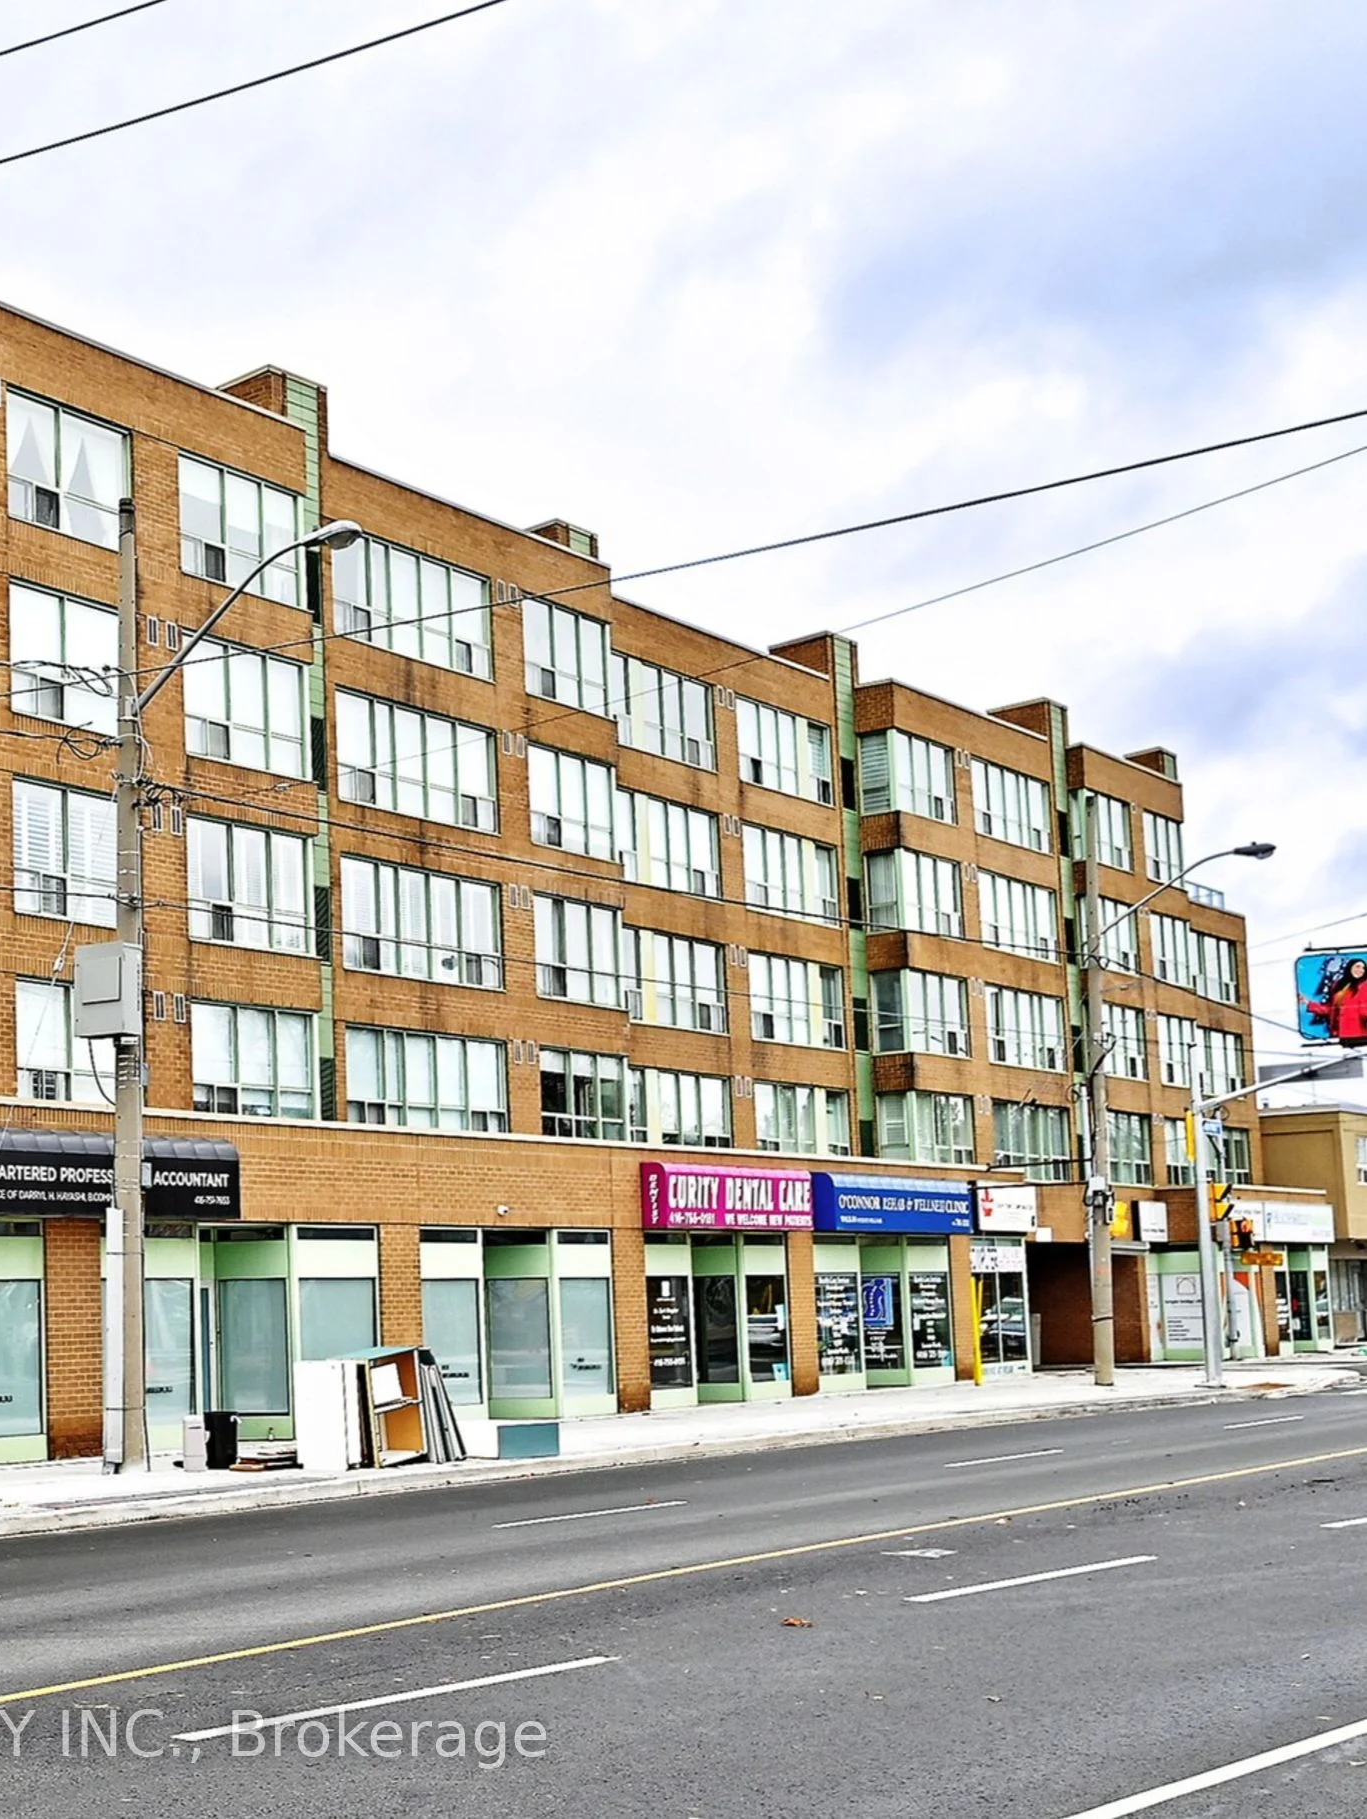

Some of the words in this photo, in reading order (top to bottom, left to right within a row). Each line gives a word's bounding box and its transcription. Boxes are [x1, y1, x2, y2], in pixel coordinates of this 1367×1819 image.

[60, 1166, 114, 1184] PROFESS
[153, 1171, 230, 1188] ACCOUNTANT
[6, 1189, 18, 1200] OF
[668, 1174, 719, 1209] CURITY
[725, 1177, 774, 1211] DENTAL
[778, 1180, 811, 1212] CARE
[838, 1193, 880, 1210] O'CONNOR
[944, 1199, 969, 1214] CLINIC
[736, 1213, 767, 1225] WELCOME
[768, 1214, 783, 1225] NEW
